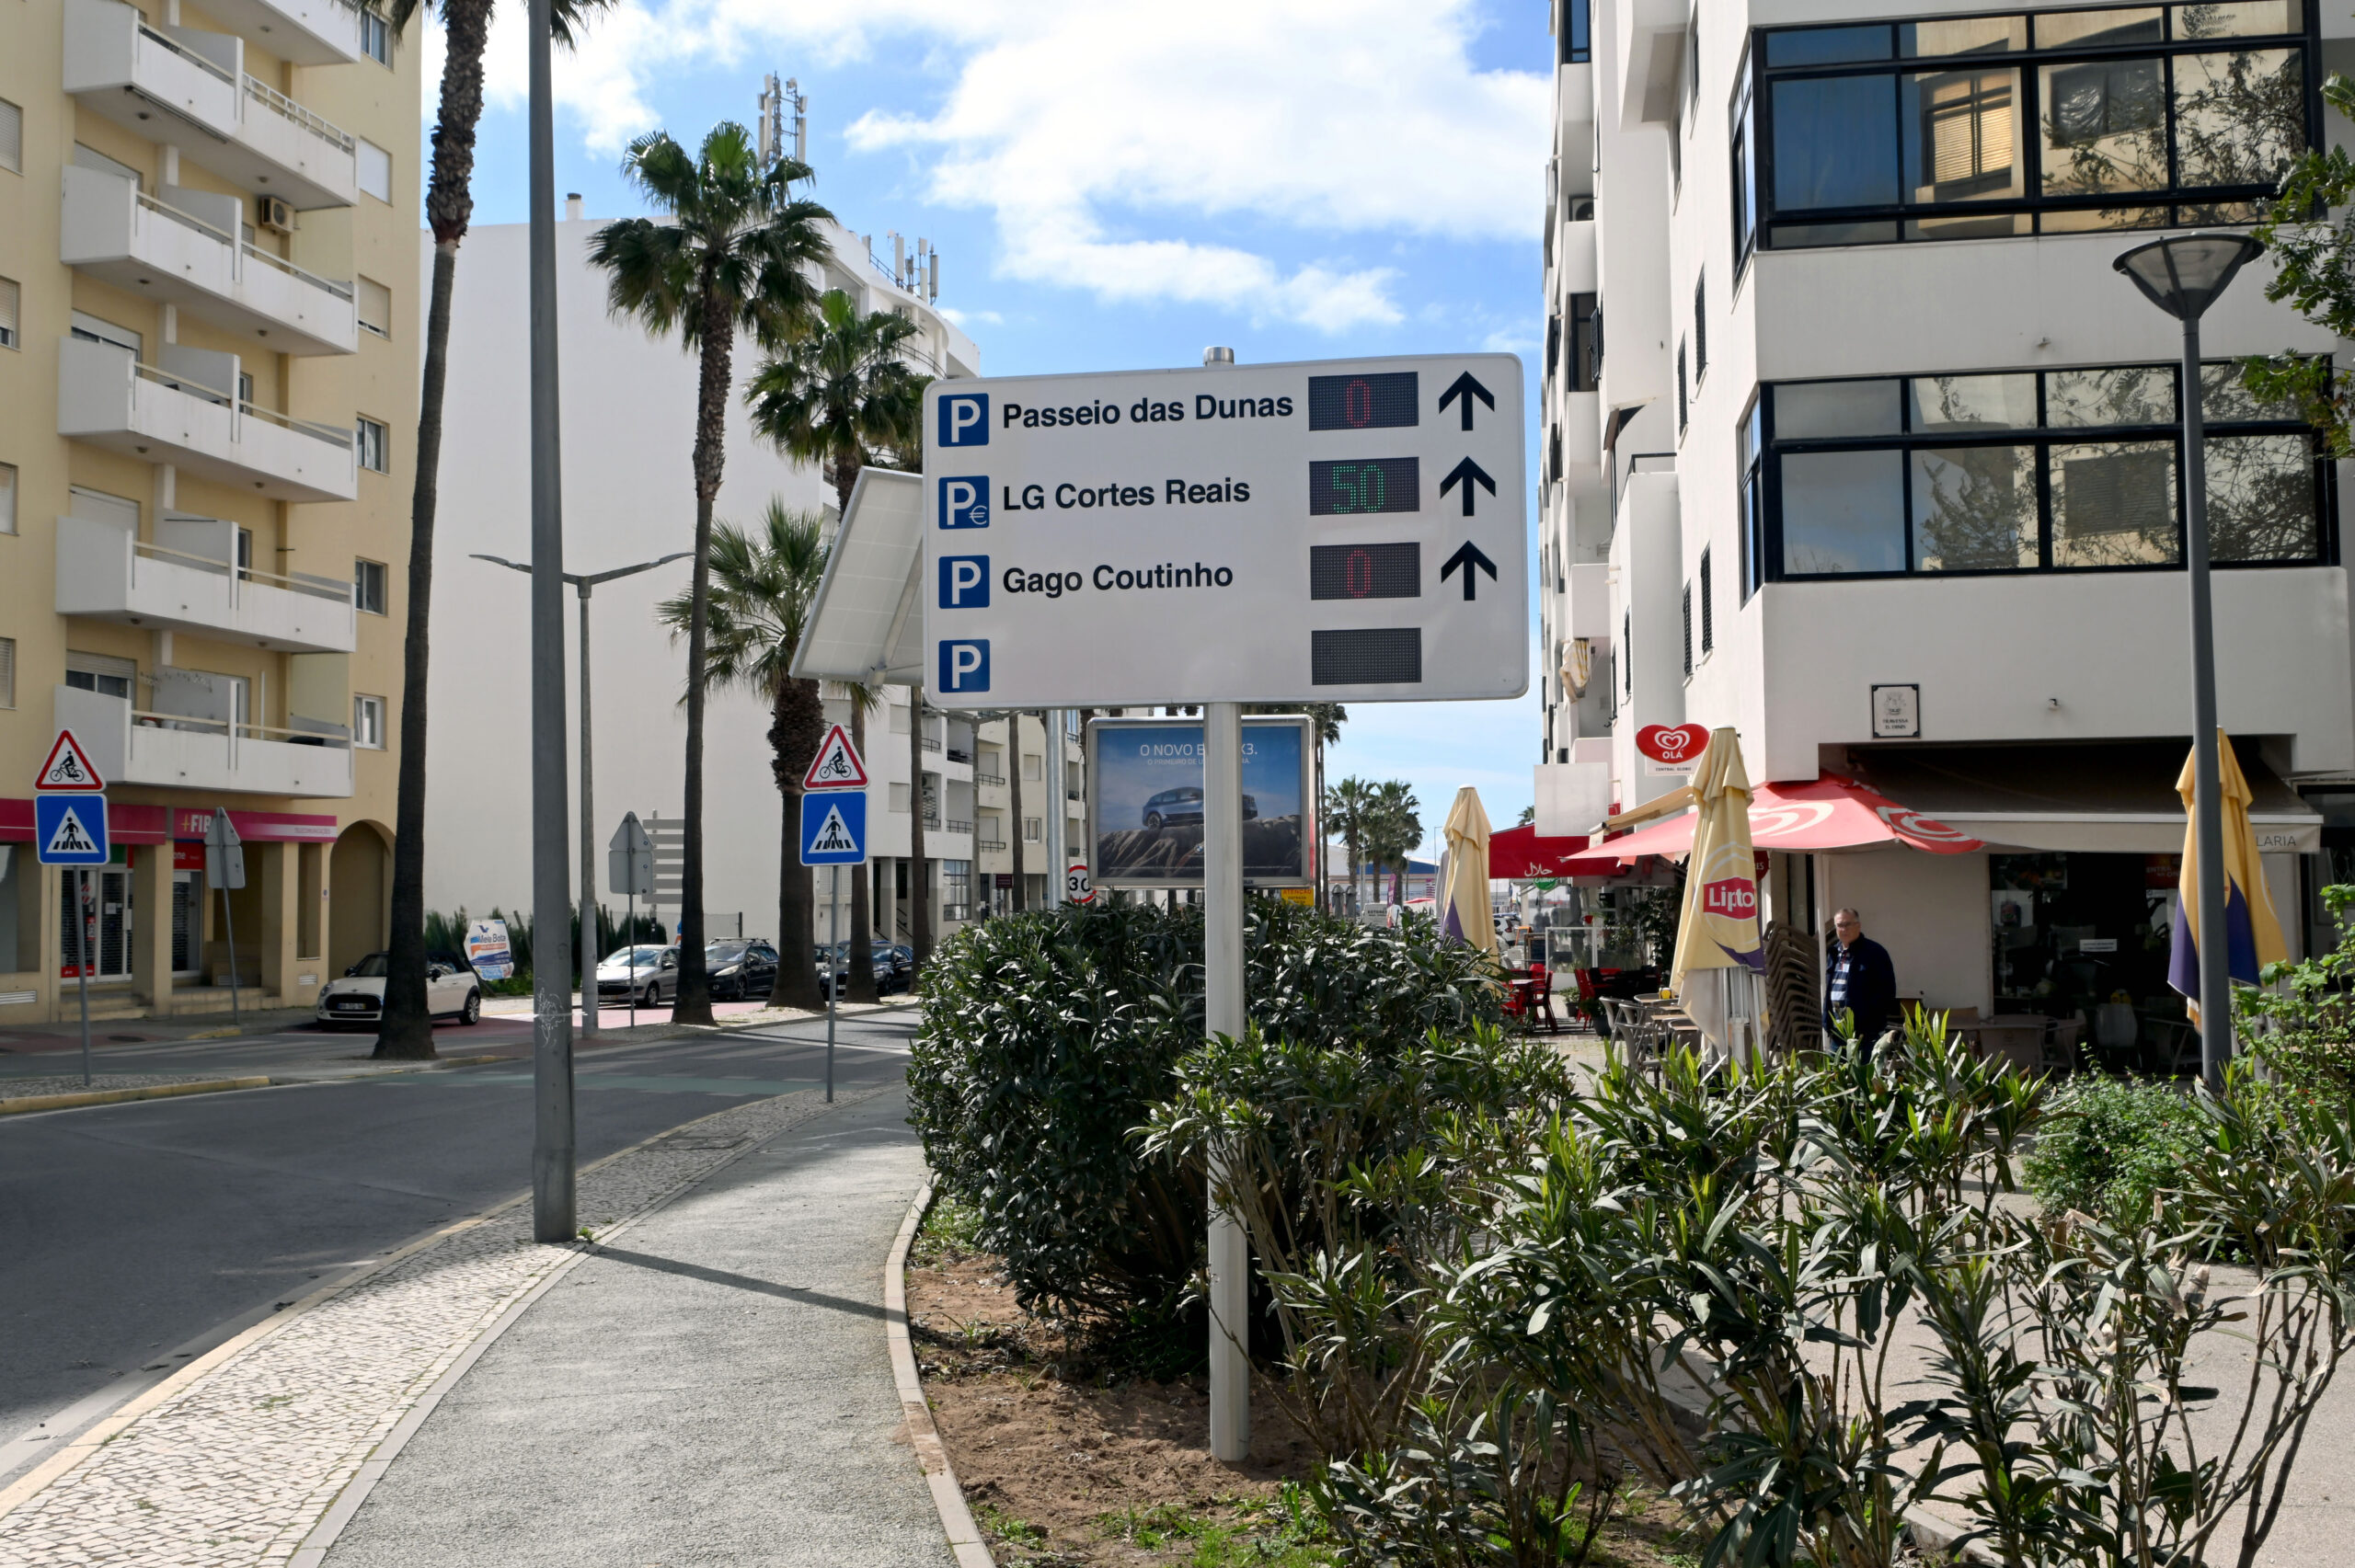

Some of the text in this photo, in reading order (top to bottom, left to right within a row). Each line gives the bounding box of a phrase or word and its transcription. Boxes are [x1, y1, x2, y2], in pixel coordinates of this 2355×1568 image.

[1003, 395, 1293, 429] Passeio das Dunas
[1347, 379, 1371, 428] 0
[1004, 476, 1250, 511] LG Cortes Reais
[1333, 464, 1384, 514] 50
[1003, 562, 1234, 599] Gago Coutinho
[1347, 550, 1372, 598] 0
[1140, 743, 1150, 756] O
[1154, 743, 1193, 756] NOVO
[1661, 748, 1683, 760] OLÁ
[1155, 758, 1187, 766] PRIMEIRO
[2256, 835, 2297, 847] LARIA
[1523, 861, 1554, 877] حلال
[1756, 862, 1764, 870] ES
[1069, 876, 1091, 892] 30
[1708, 886, 1755, 912] Lipto
